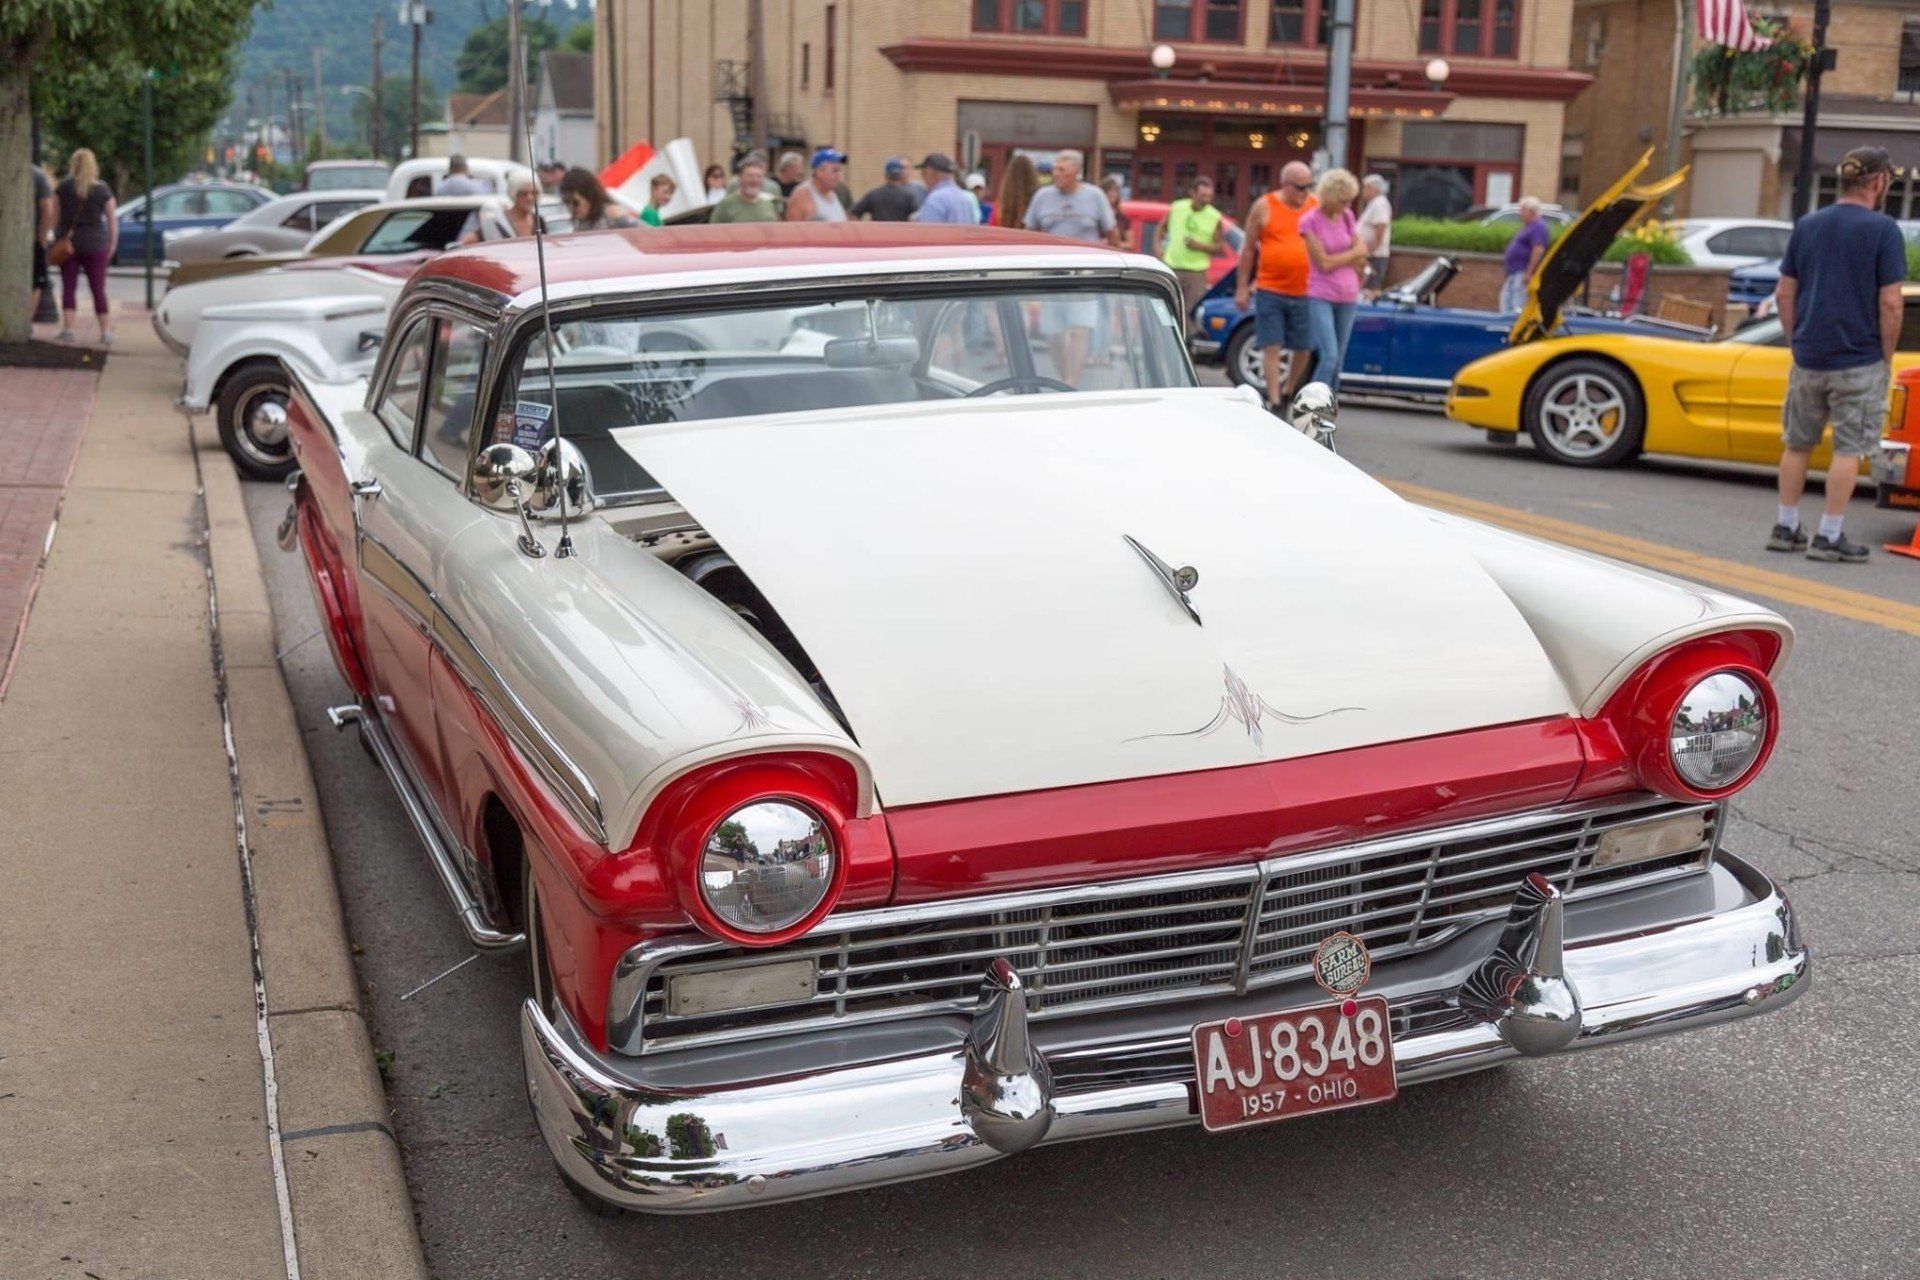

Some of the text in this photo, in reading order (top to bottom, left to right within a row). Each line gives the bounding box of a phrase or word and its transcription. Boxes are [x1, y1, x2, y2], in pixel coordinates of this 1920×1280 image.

[1320, 943, 1358, 975] FARM
[1325, 953, 1365, 986] BUREAU
[1241, 1091, 1286, 1117] 1957
[1308, 1078, 1357, 1104] OHIO
